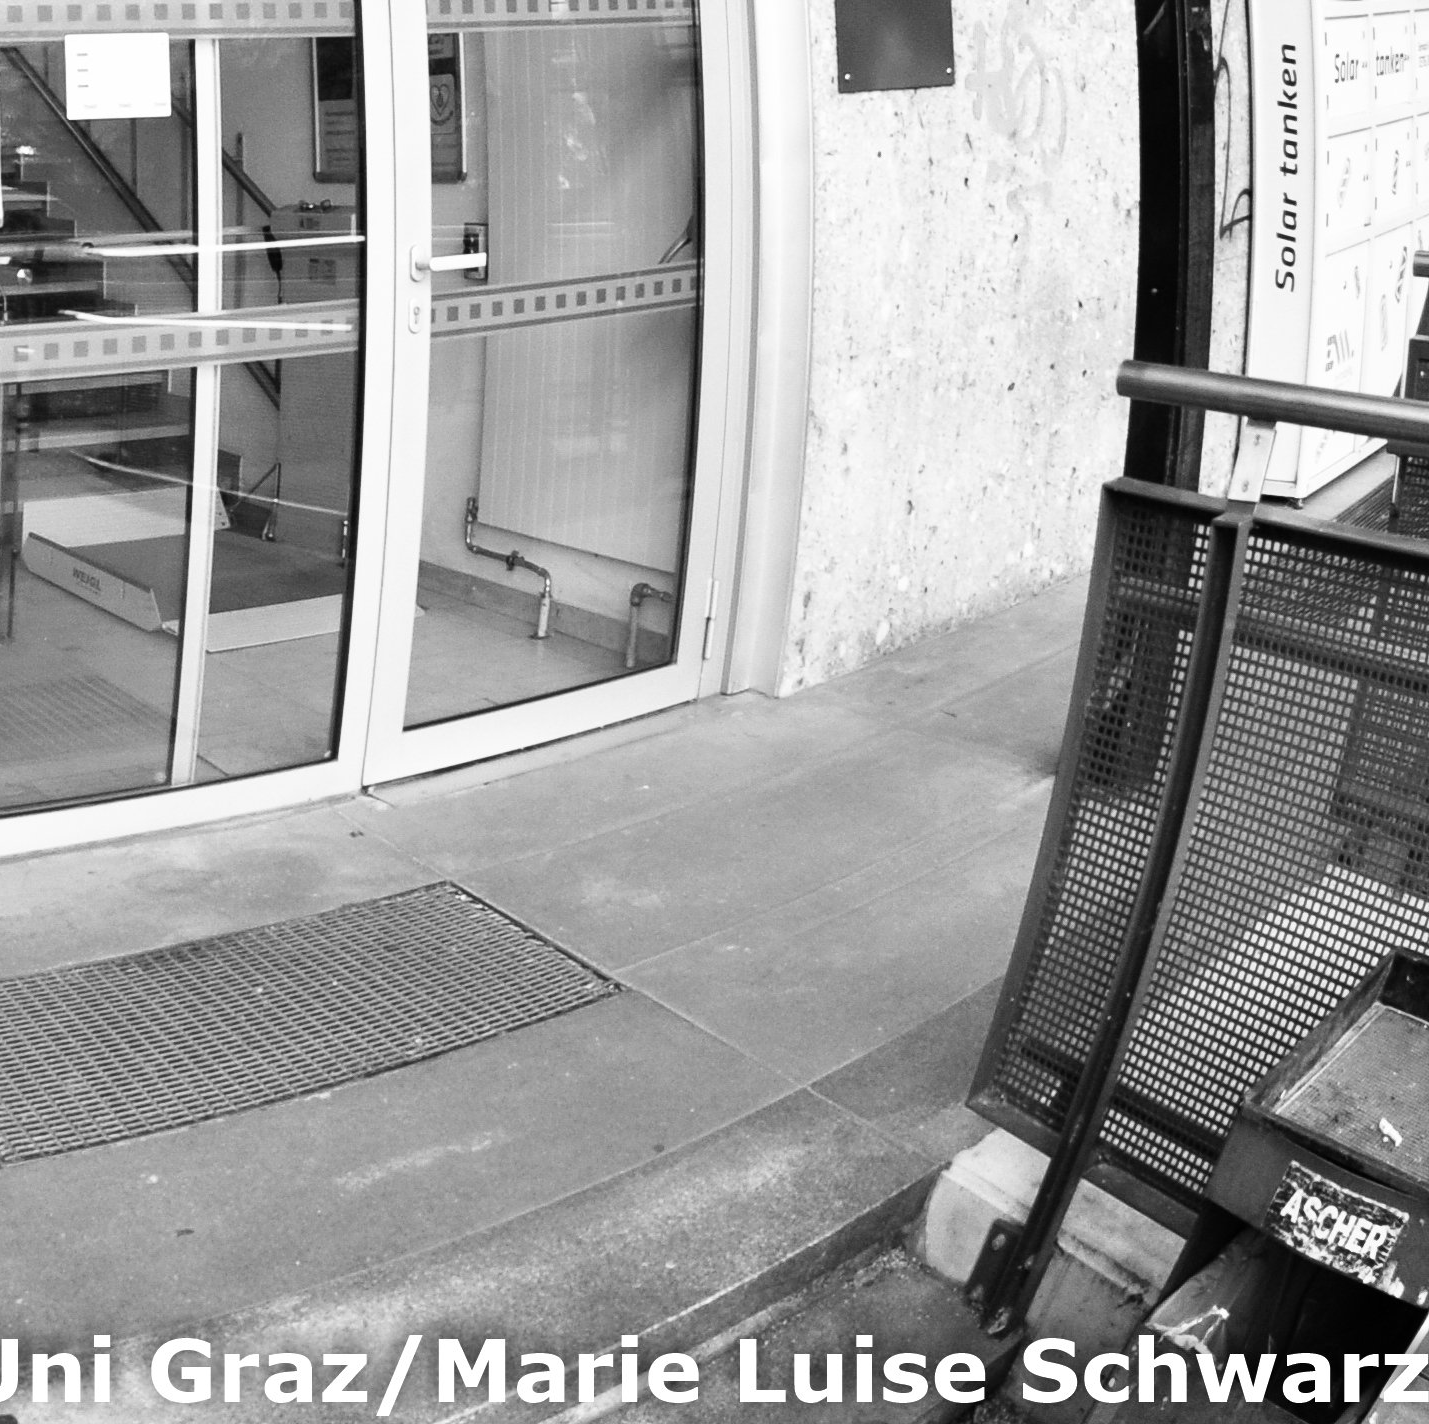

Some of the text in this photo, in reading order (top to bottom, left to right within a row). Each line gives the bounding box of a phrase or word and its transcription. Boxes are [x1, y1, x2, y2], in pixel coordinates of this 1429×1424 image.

[1334, 52, 1360, 84] Solar
[1375, 46, 1406, 77] tanken
[1275, 44, 1298, 293] Solar tanken
[1280, 1189, 1388, 1260] ASCHER
